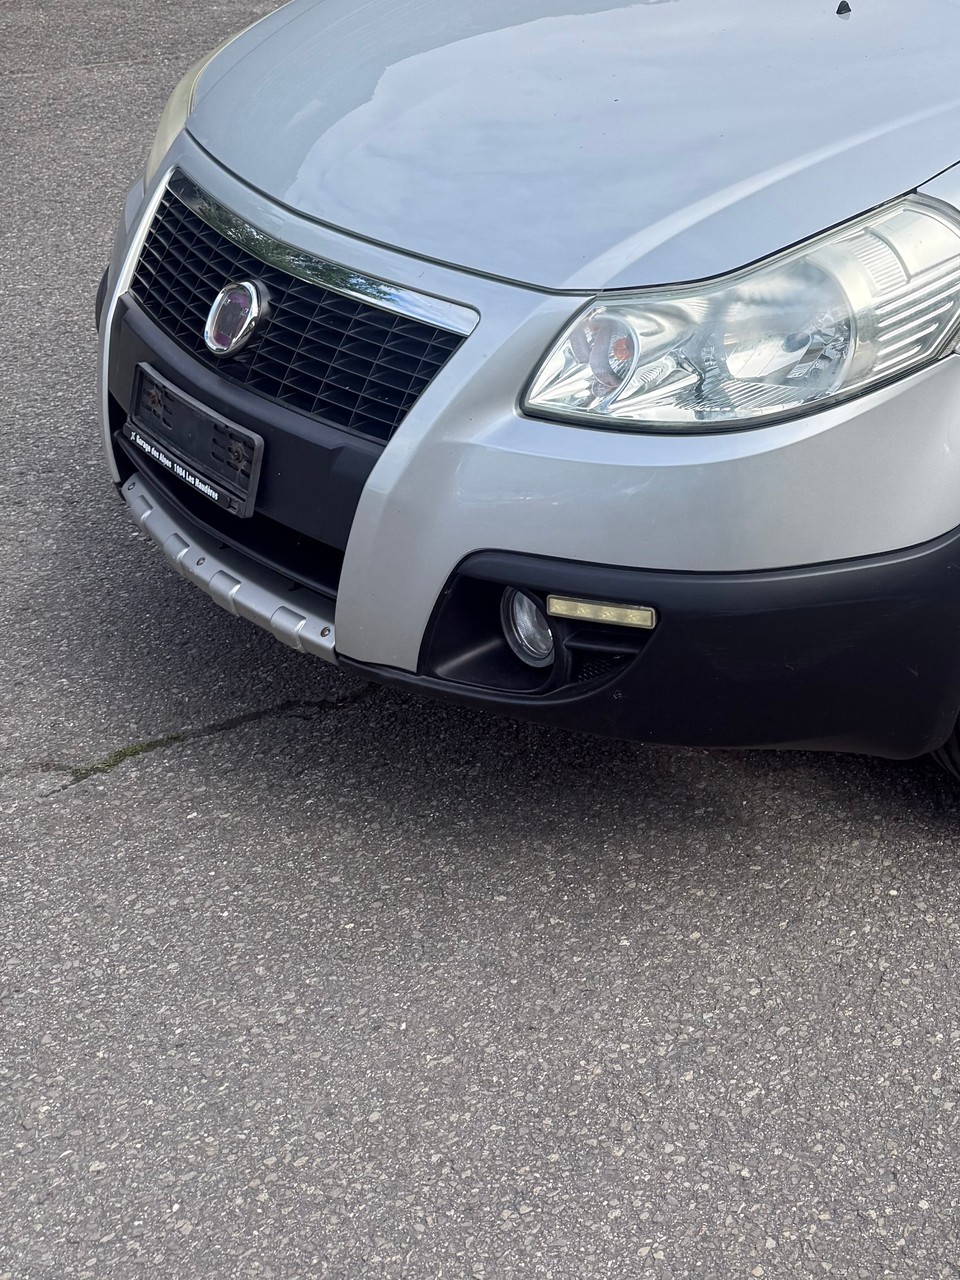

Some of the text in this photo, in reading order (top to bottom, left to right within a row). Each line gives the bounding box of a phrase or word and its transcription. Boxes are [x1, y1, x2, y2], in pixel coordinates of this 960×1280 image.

[136, 435, 150, 452] Garage
[151, 447, 159, 459] des
[159, 453, 172, 468] Alpes
[186, 471, 195, 485] Les
